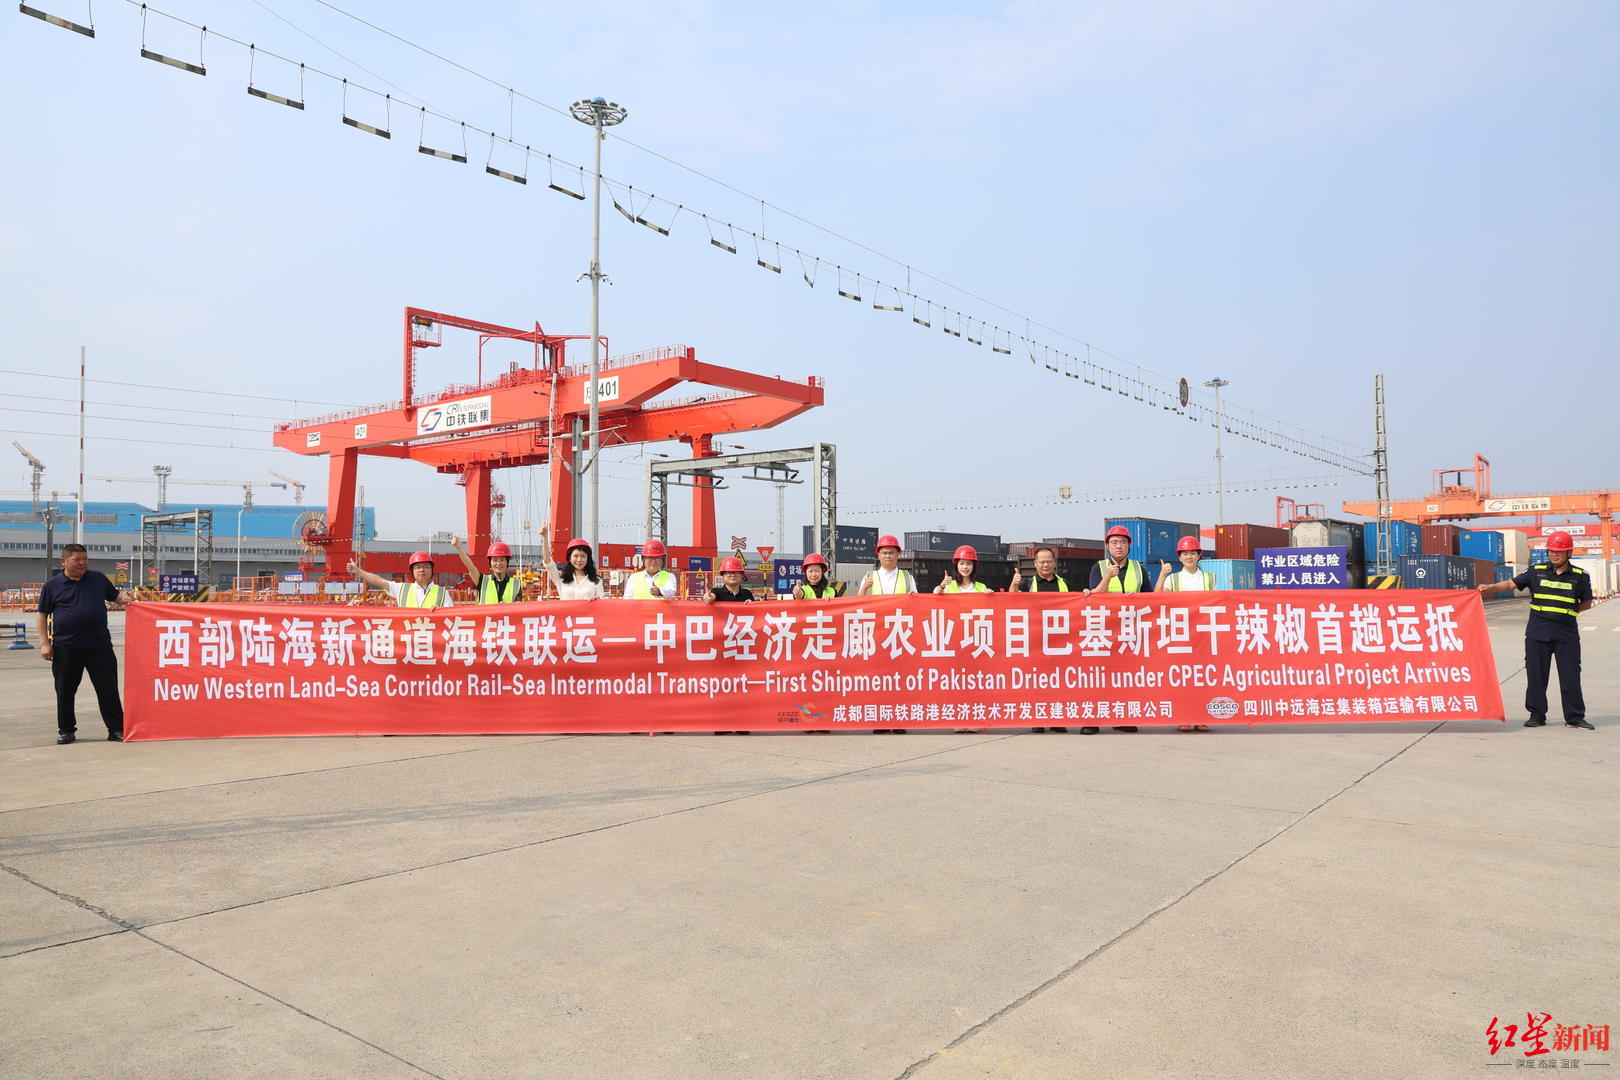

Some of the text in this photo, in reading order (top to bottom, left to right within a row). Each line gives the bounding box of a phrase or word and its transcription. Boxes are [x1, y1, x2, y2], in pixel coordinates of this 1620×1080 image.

[446, 409, 489, 427] 中铁联集
[1261, 553, 1340, 568] 作业区域危险
[1261, 572, 1340, 586] 禁止人员进入
[154, 678, 199, 701] New
[204, 676, 284, 700] Western
[385, 673, 462, 697] Corridor
[551, 671, 652, 696] Intermodal
[811, 668, 900, 697] Shipment
[905, 667, 923, 691] of
[928, 667, 1006, 691] Pakistan
[1011, 666, 1060, 690] Dried
[1064, 665, 1106, 689] Chili
[1111, 665, 1164, 688] under
[1168, 664, 1217, 688] CPEC
[1222, 663, 1331, 692] Agricultural
[1334, 662, 1400, 689] Project
[1405, 661, 1472, 685] Arrives
[832, 700, 1173, 723] 成都国际铁路港经济技术开发区建设发展有限公司
[1244, 695, 1479, 717] 四川中远海运集装箱运输有限公司
